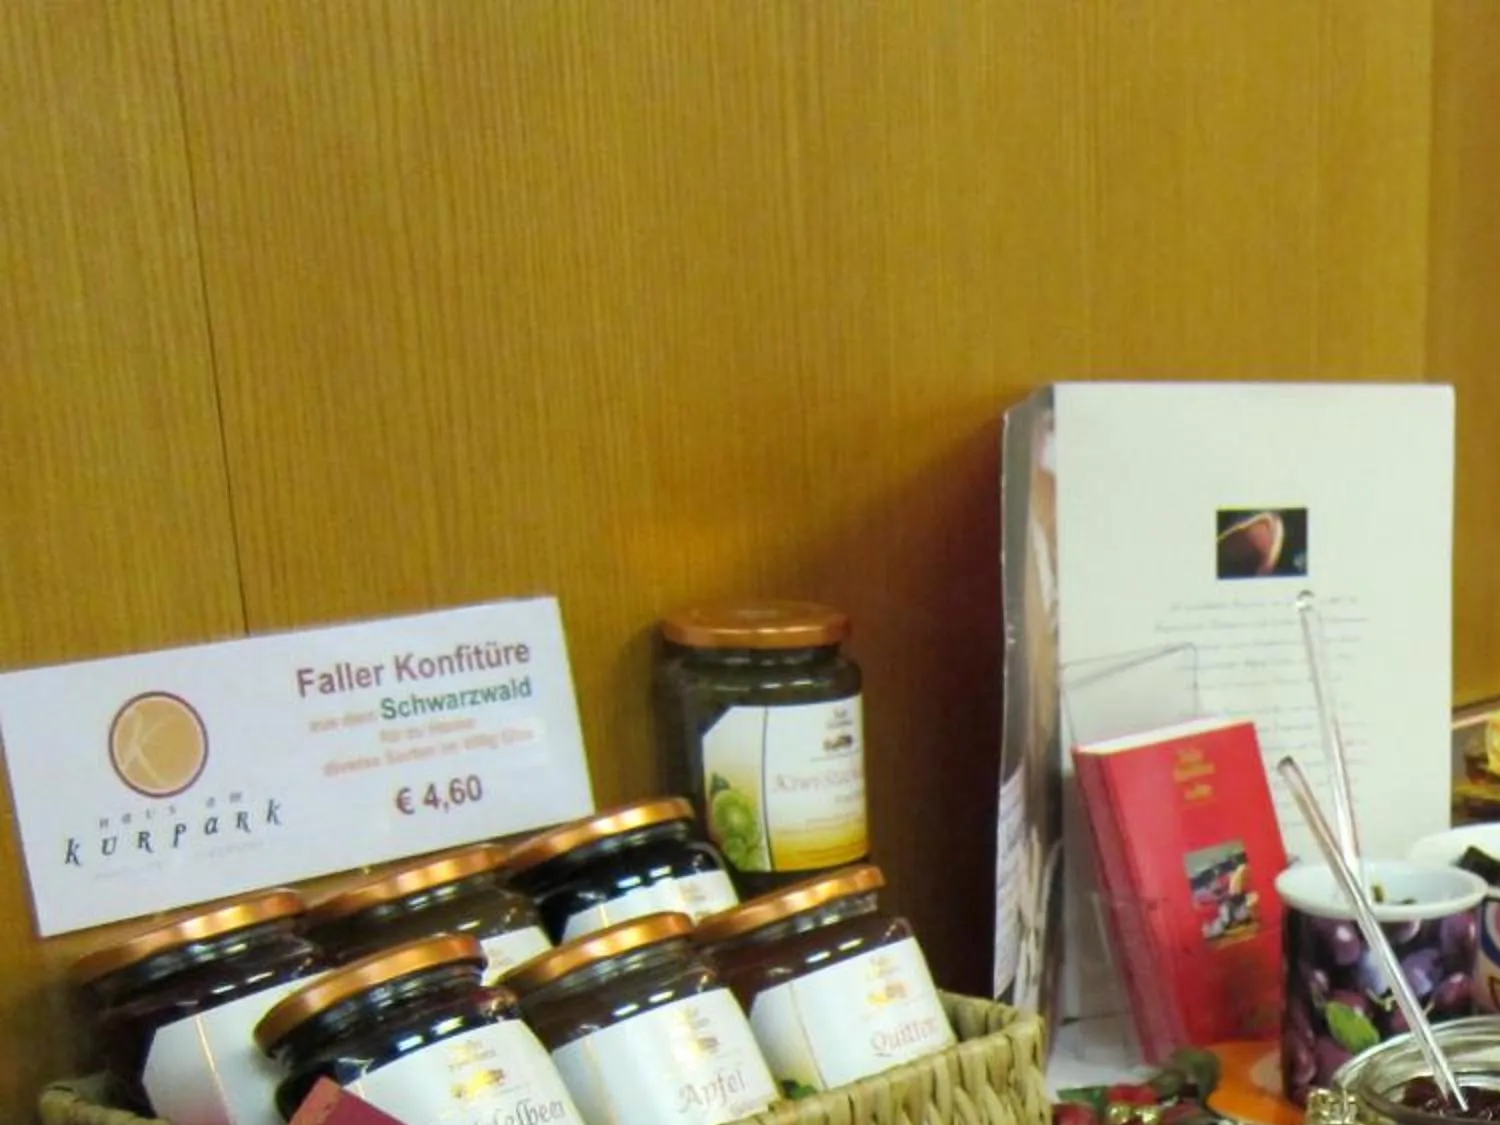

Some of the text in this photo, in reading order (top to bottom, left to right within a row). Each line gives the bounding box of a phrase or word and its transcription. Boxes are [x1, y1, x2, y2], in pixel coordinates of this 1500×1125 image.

[296, 641, 531, 698] Faller Konfitüre
[380, 676, 533, 720] Schwarzwald
[422, 774, 484, 813] 4,60
